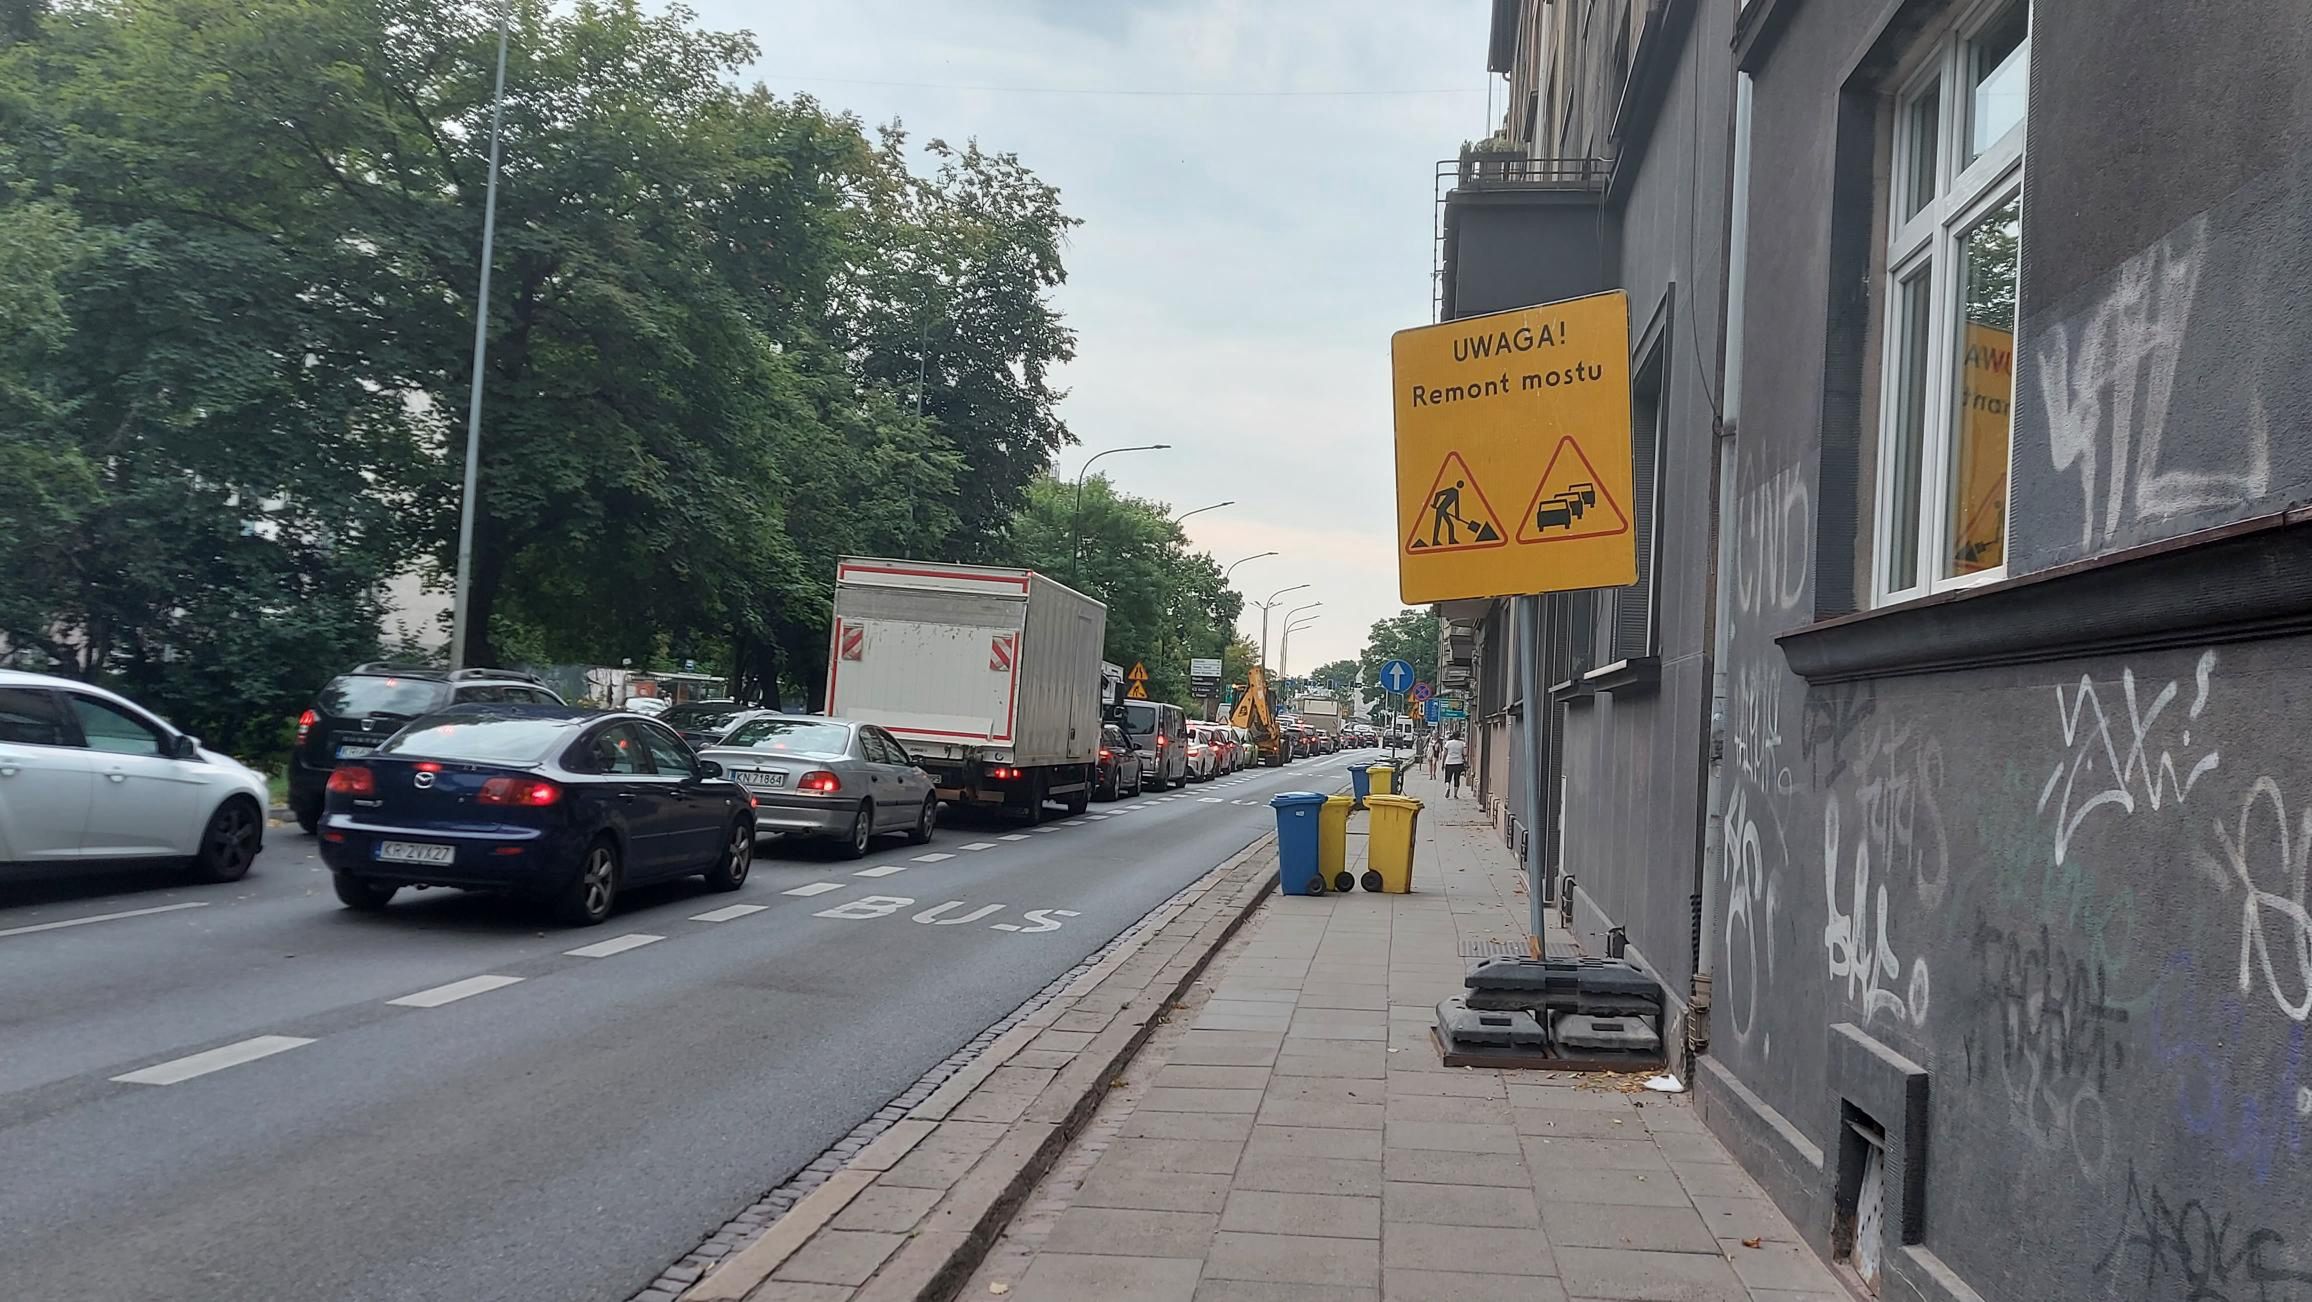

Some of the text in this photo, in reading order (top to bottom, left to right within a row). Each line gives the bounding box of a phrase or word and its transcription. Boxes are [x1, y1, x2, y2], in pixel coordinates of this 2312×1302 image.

[1453, 321, 1566, 362] UWAGA!
[1412, 360, 1603, 407] Remont mostu
[736, 771, 782, 785] KN 71864
[812, 895, 1081, 933] BUS
